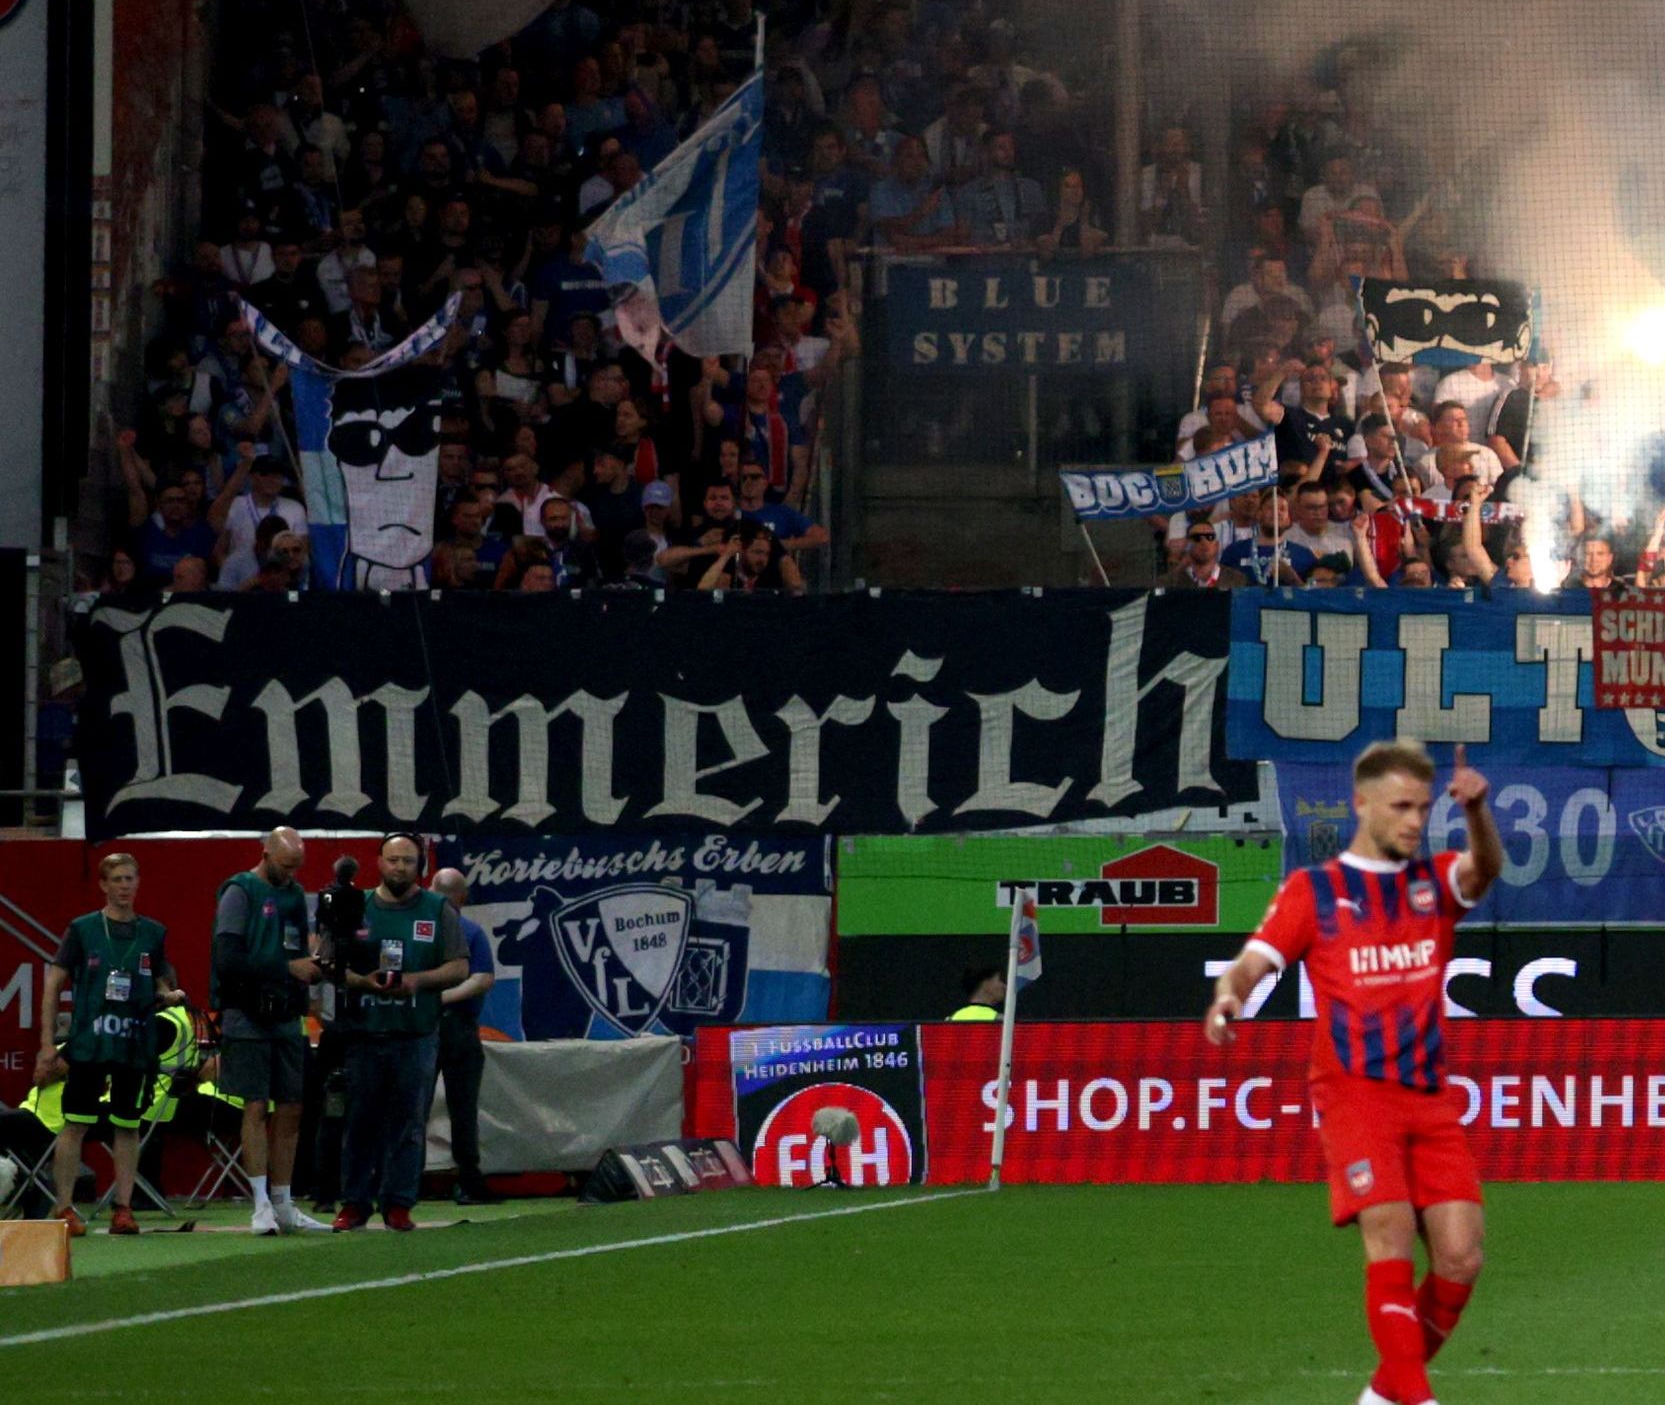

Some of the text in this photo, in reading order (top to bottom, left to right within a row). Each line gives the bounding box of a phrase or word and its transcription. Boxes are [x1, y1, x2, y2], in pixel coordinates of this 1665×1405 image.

[928, 276, 1112, 309] BLUE
[913, 332, 1127, 365] SYSTEM
[91, 595, 1229, 830] Emmerich
[693, 834, 806, 873] Erben
[999, 880, 1195, 906] TRAUB
[614, 909, 681, 932] Bochum
[632, 932, 668, 952] 1848
[1380, 939, 1436, 973] MHP
[865, 1051, 909, 1070] 1846
